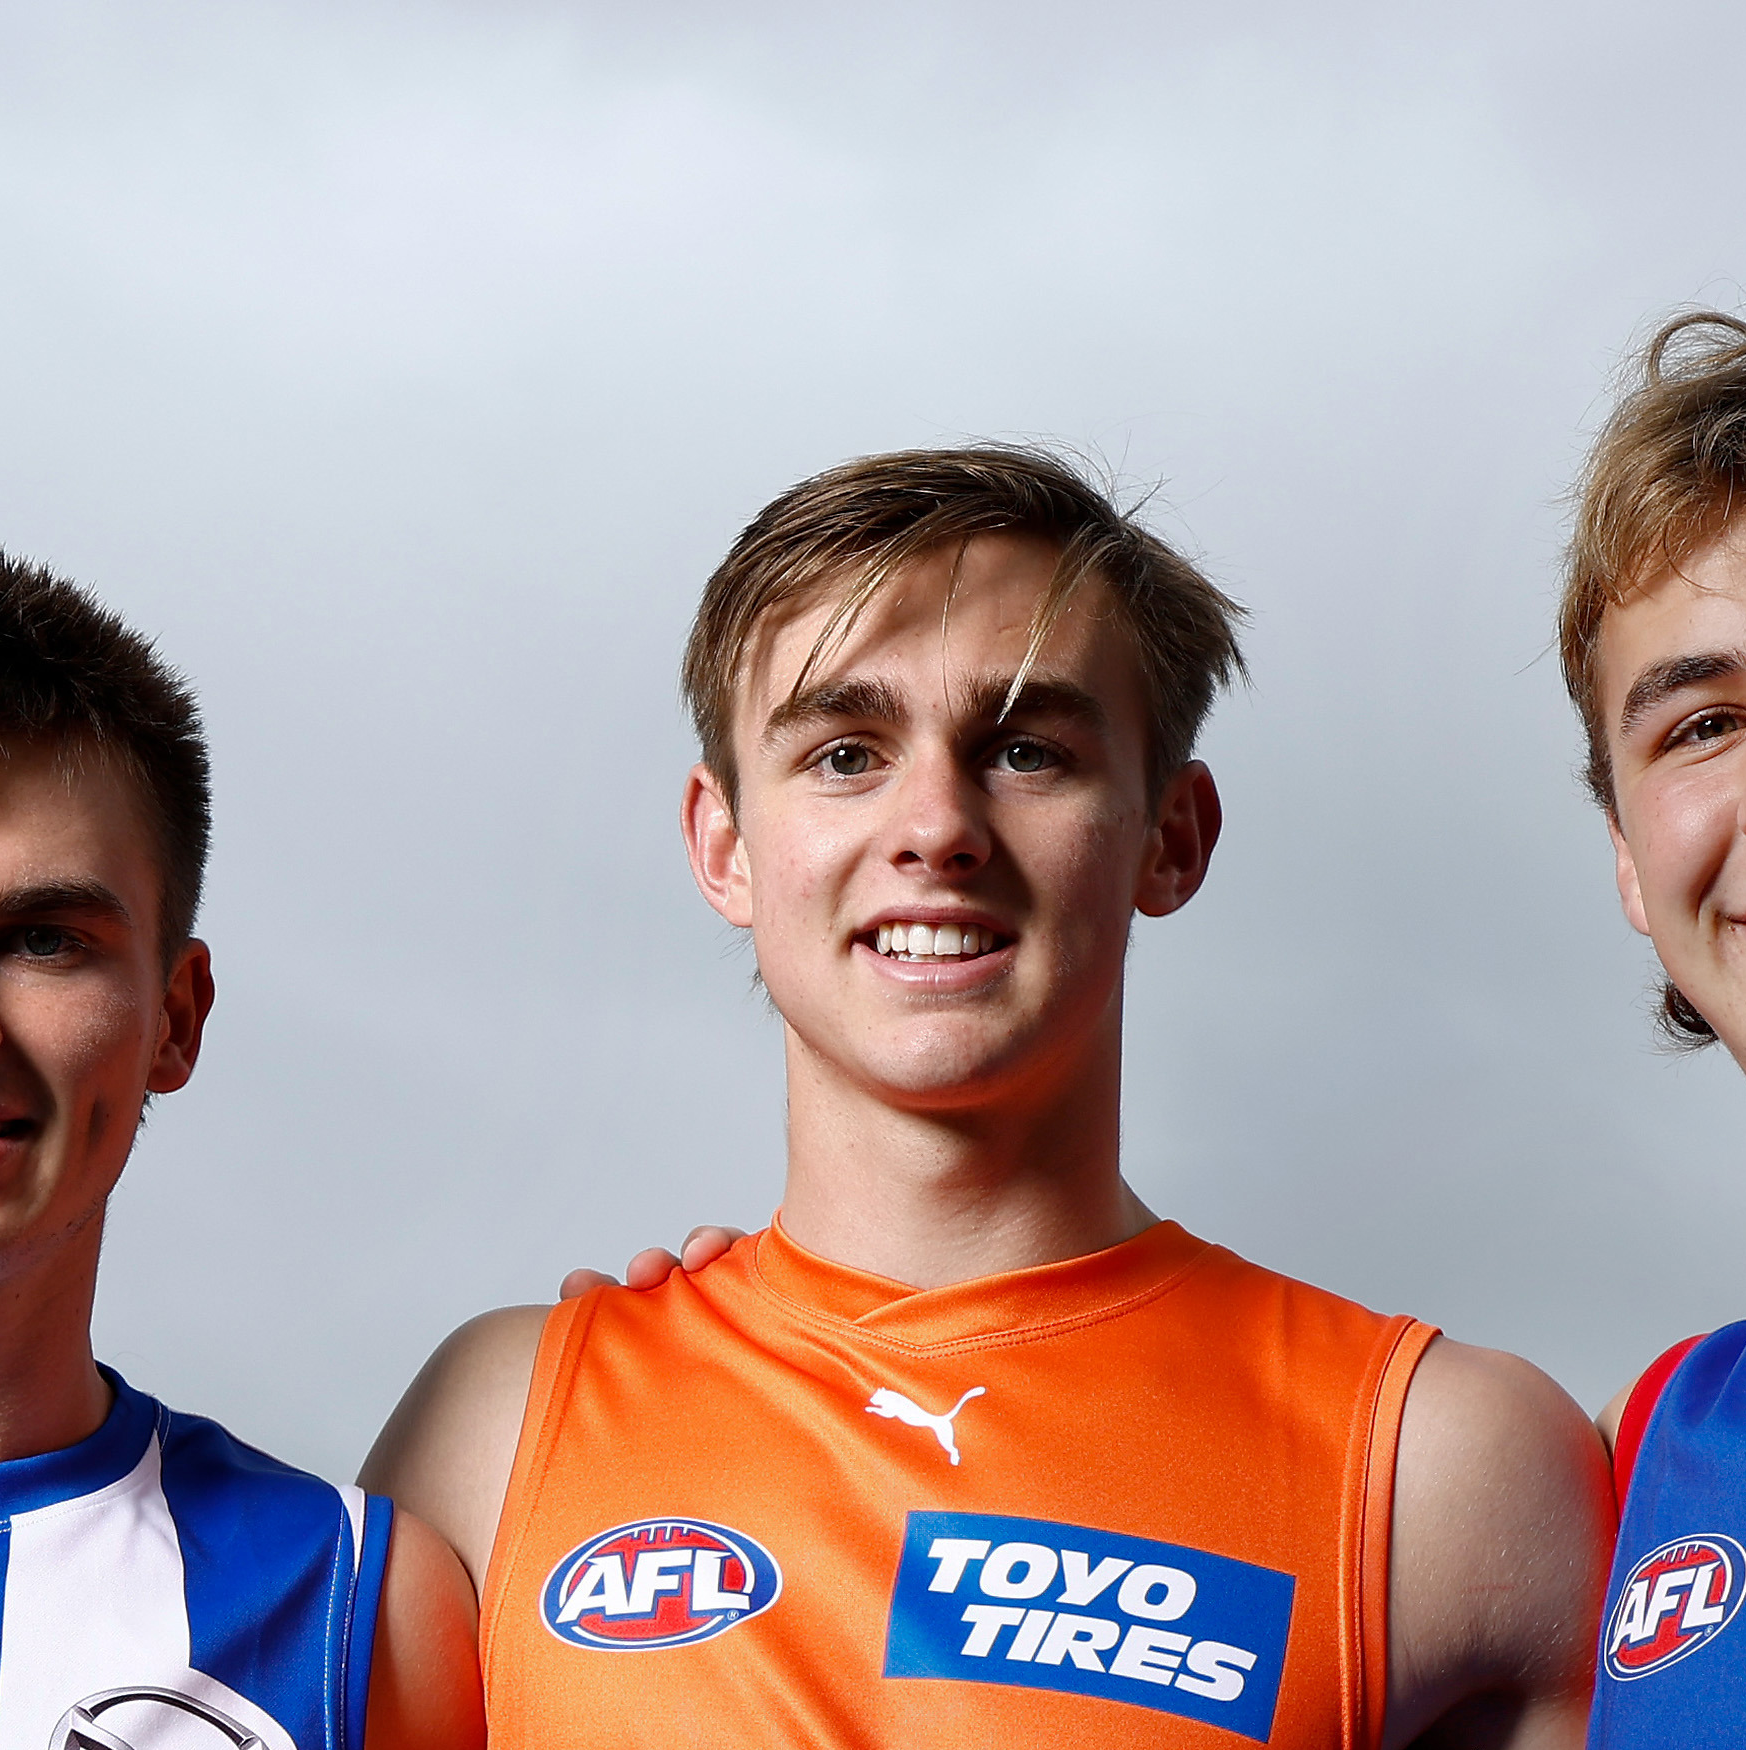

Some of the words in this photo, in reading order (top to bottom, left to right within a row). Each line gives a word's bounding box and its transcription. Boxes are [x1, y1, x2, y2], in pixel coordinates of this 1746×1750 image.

[555, 1546, 751, 1625] AFL
[927, 1538, 1198, 1622] TOYO
[1611, 1564, 1725, 1652] AFL
[959, 1605, 1258, 1703] TIRES
